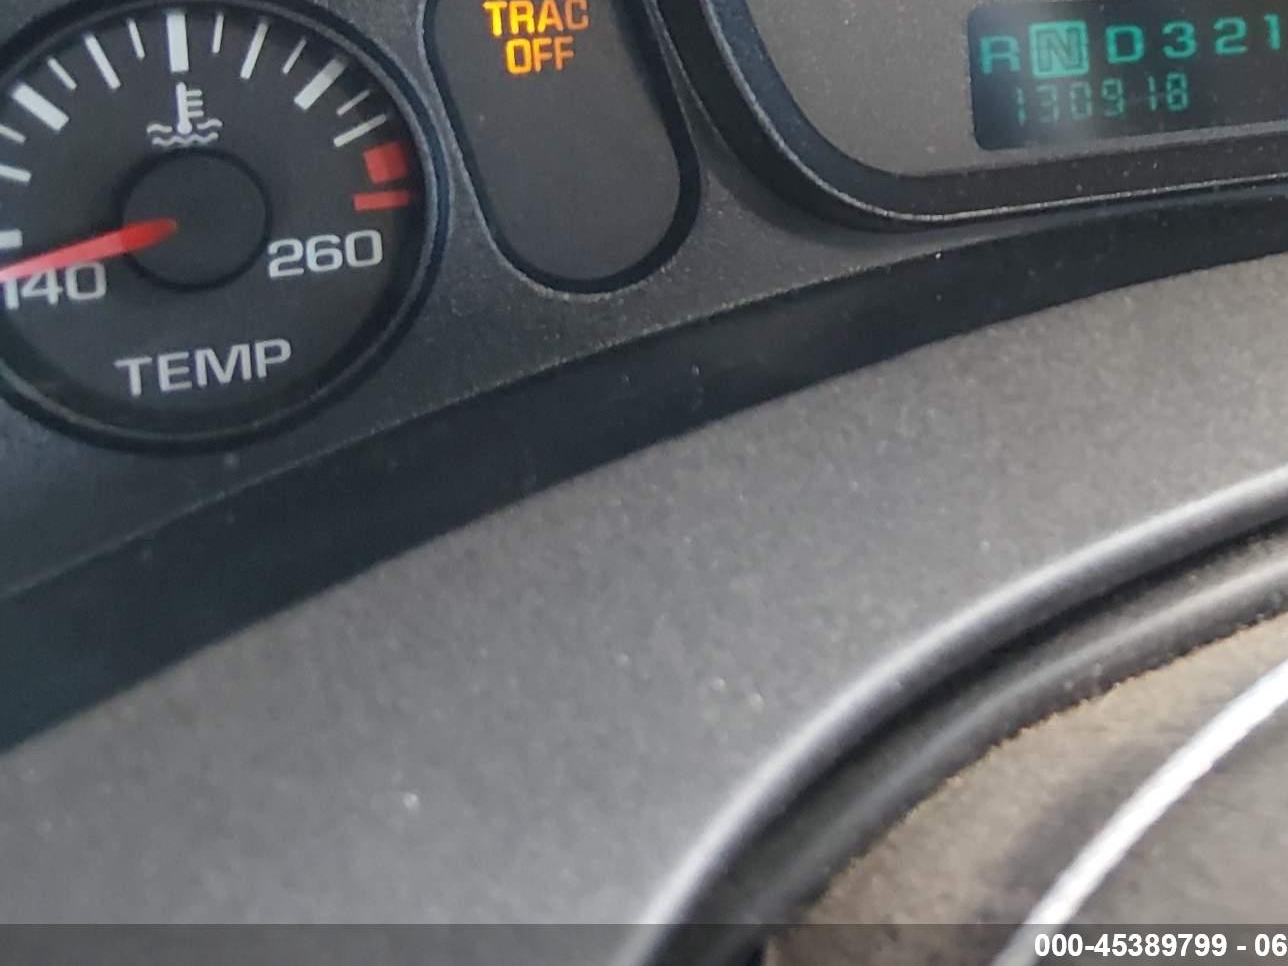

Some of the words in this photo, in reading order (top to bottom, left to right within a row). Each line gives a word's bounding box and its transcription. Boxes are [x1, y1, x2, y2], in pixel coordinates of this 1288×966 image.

[505, 35, 575, 75] OFF
[980, 34, 1021, 74] R
[1033, 24, 1084, 74] N
[1105, 24, 1144, 64] D
[1162, 21, 1197, 58] 3
[1213, 17, 1248, 55] 2
[1263, 13, 1282, 51] 1
[1016, 72, 1189, 126] 130918
[267, 230, 384, 279] 260
[115, 337, 292, 397] TEMP
